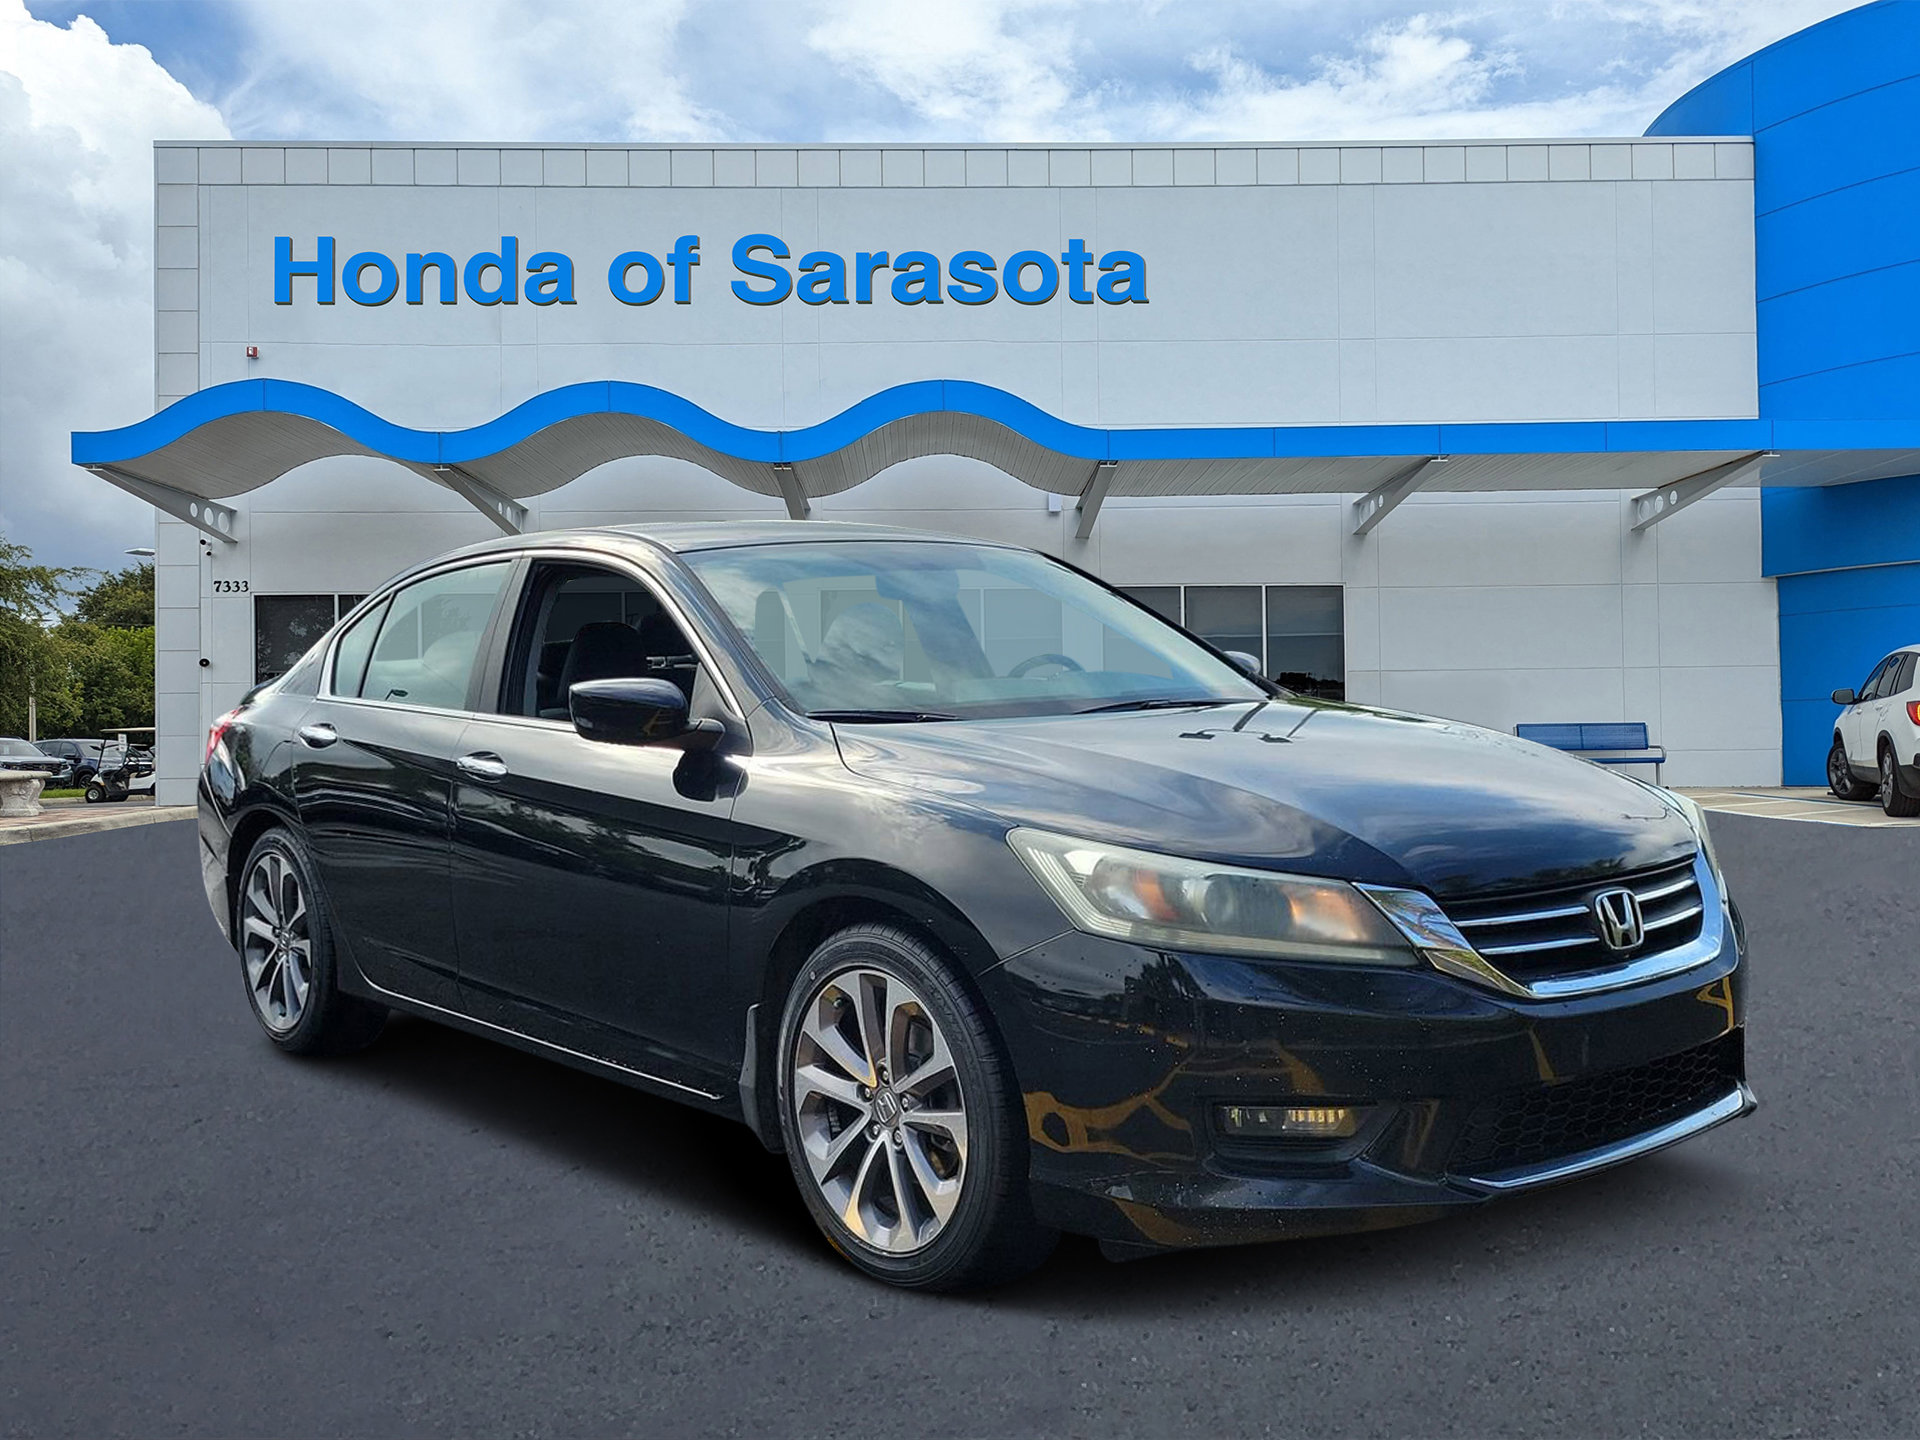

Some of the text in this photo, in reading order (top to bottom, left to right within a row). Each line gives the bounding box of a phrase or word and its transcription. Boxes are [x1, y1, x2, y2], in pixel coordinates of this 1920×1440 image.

[273, 233, 1150, 306] Honda of Sarasota
[213, 580, 250, 593] 7333
